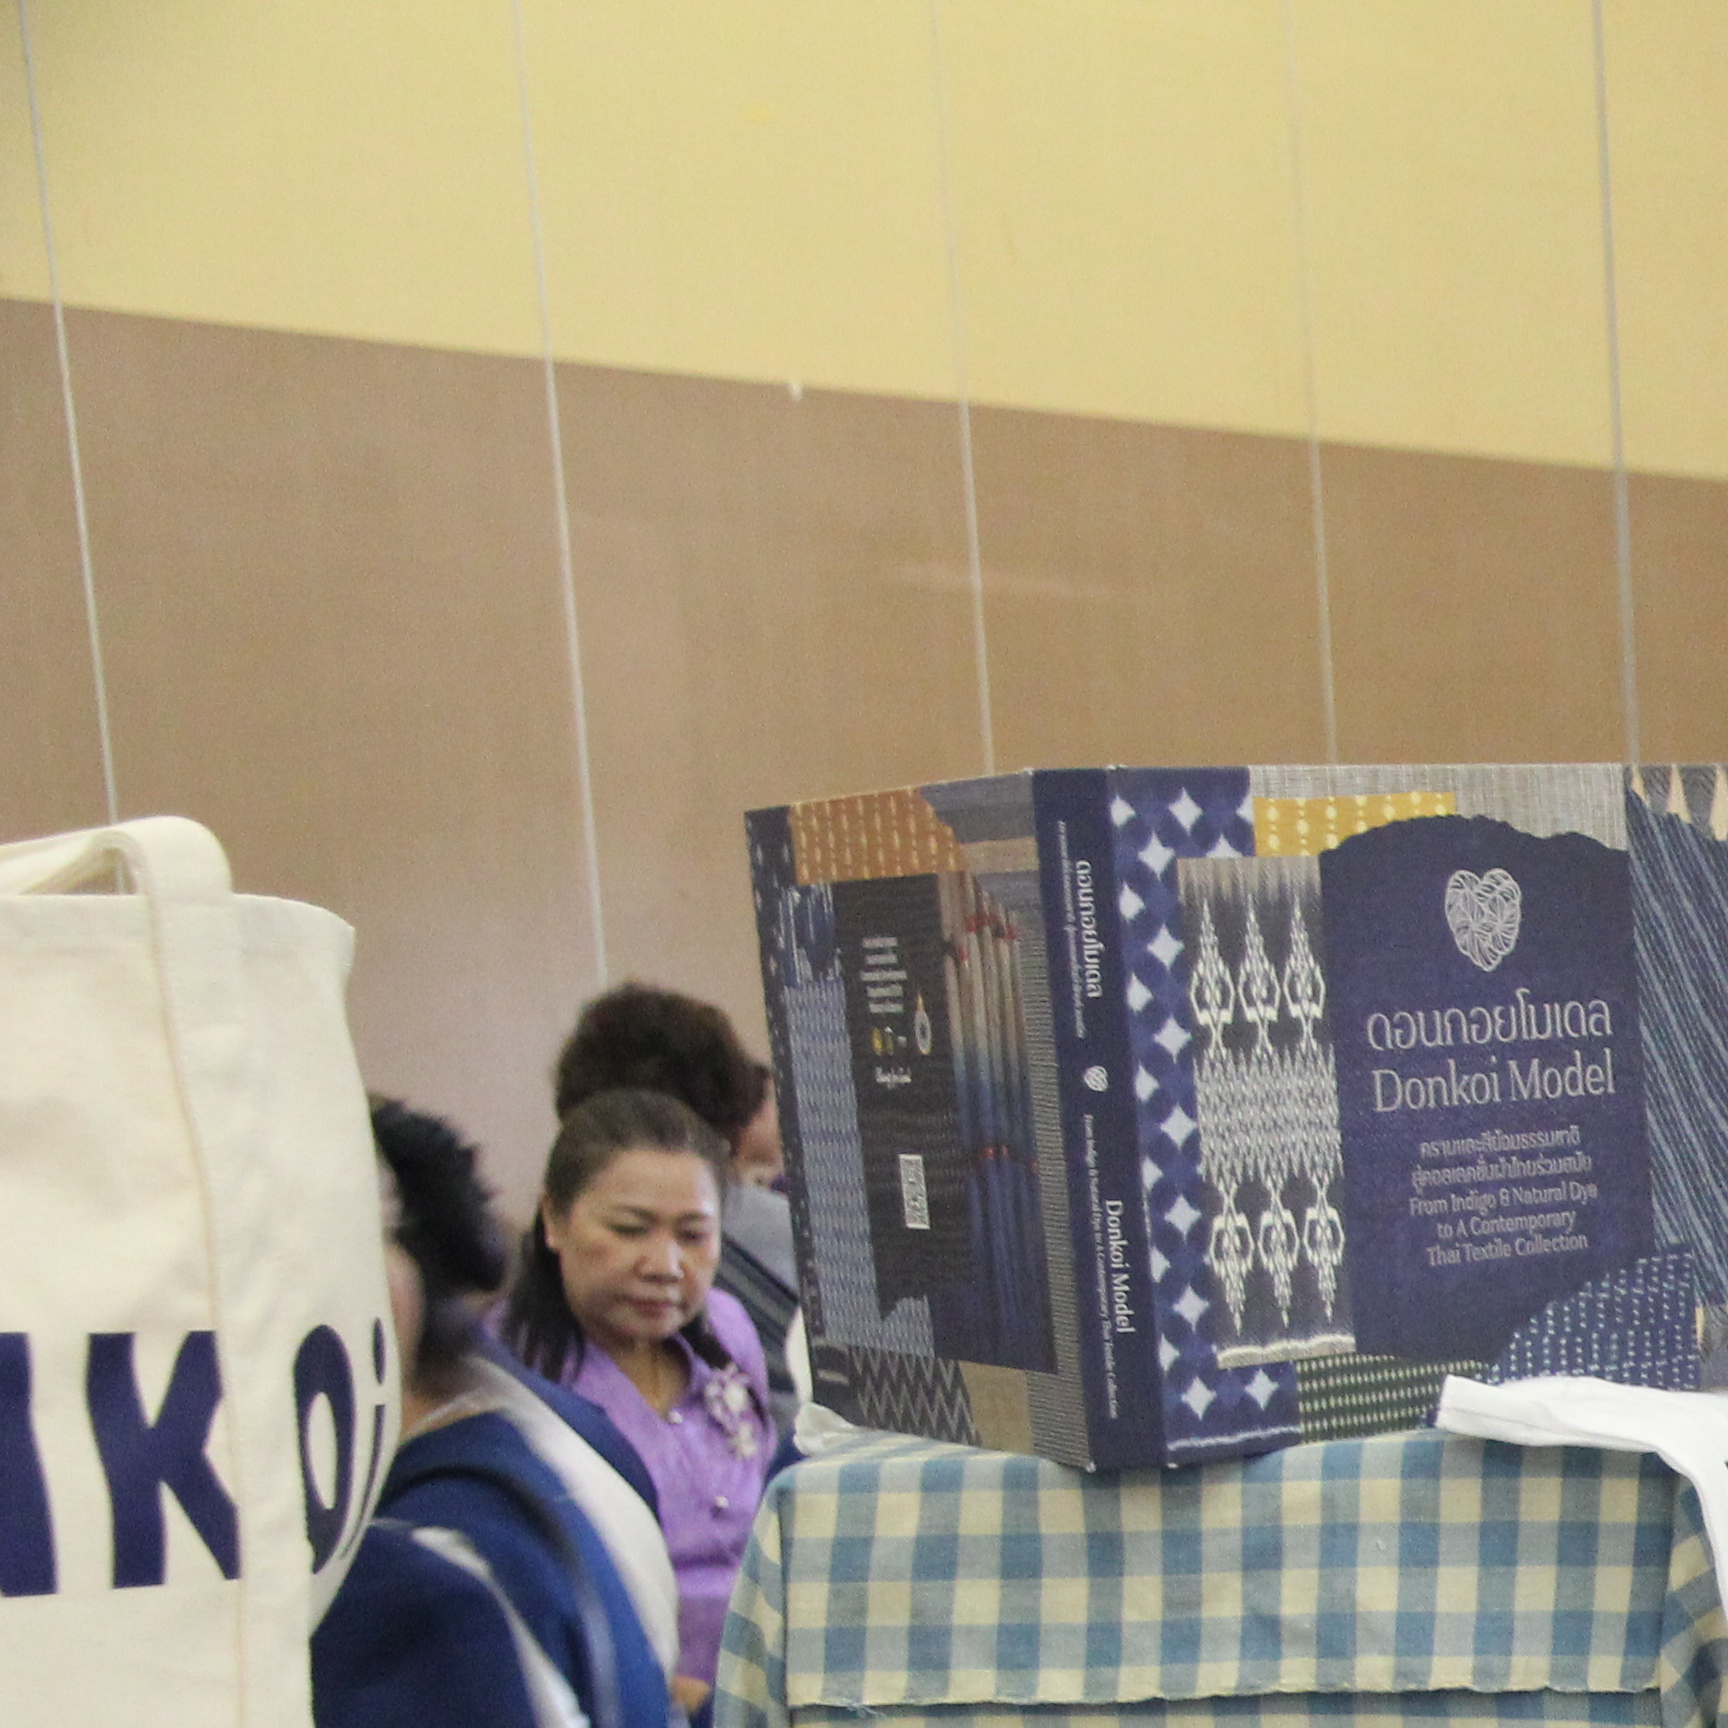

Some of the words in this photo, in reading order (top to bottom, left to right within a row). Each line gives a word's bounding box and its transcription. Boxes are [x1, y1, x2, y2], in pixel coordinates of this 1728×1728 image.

[1366, 987, 1614, 1051] ดอนกอยโมเดล
[1371, 1055, 1502, 1113] Donkoi
[1506, 1047, 1616, 1102] Model
[1409, 1197, 1448, 1217] From
[1450, 1190, 1496, 1216] Indigo
[1512, 1181, 1567, 1206] Natural
[1569, 1180, 1598, 1205] Dye
[1436, 1224, 1453, 1240] to
[1456, 1219, 1469, 1237] A
[1470, 1209, 1577, 1236] Contemporary
[1105, 1199, 1131, 1269] Donkoi
[1425, 1242, 1461, 1266] Thai
[1464, 1237, 1511, 1262] Textile
[1515, 1233, 1588, 1257] Collection
[1111, 1272, 1137, 1334] Model
